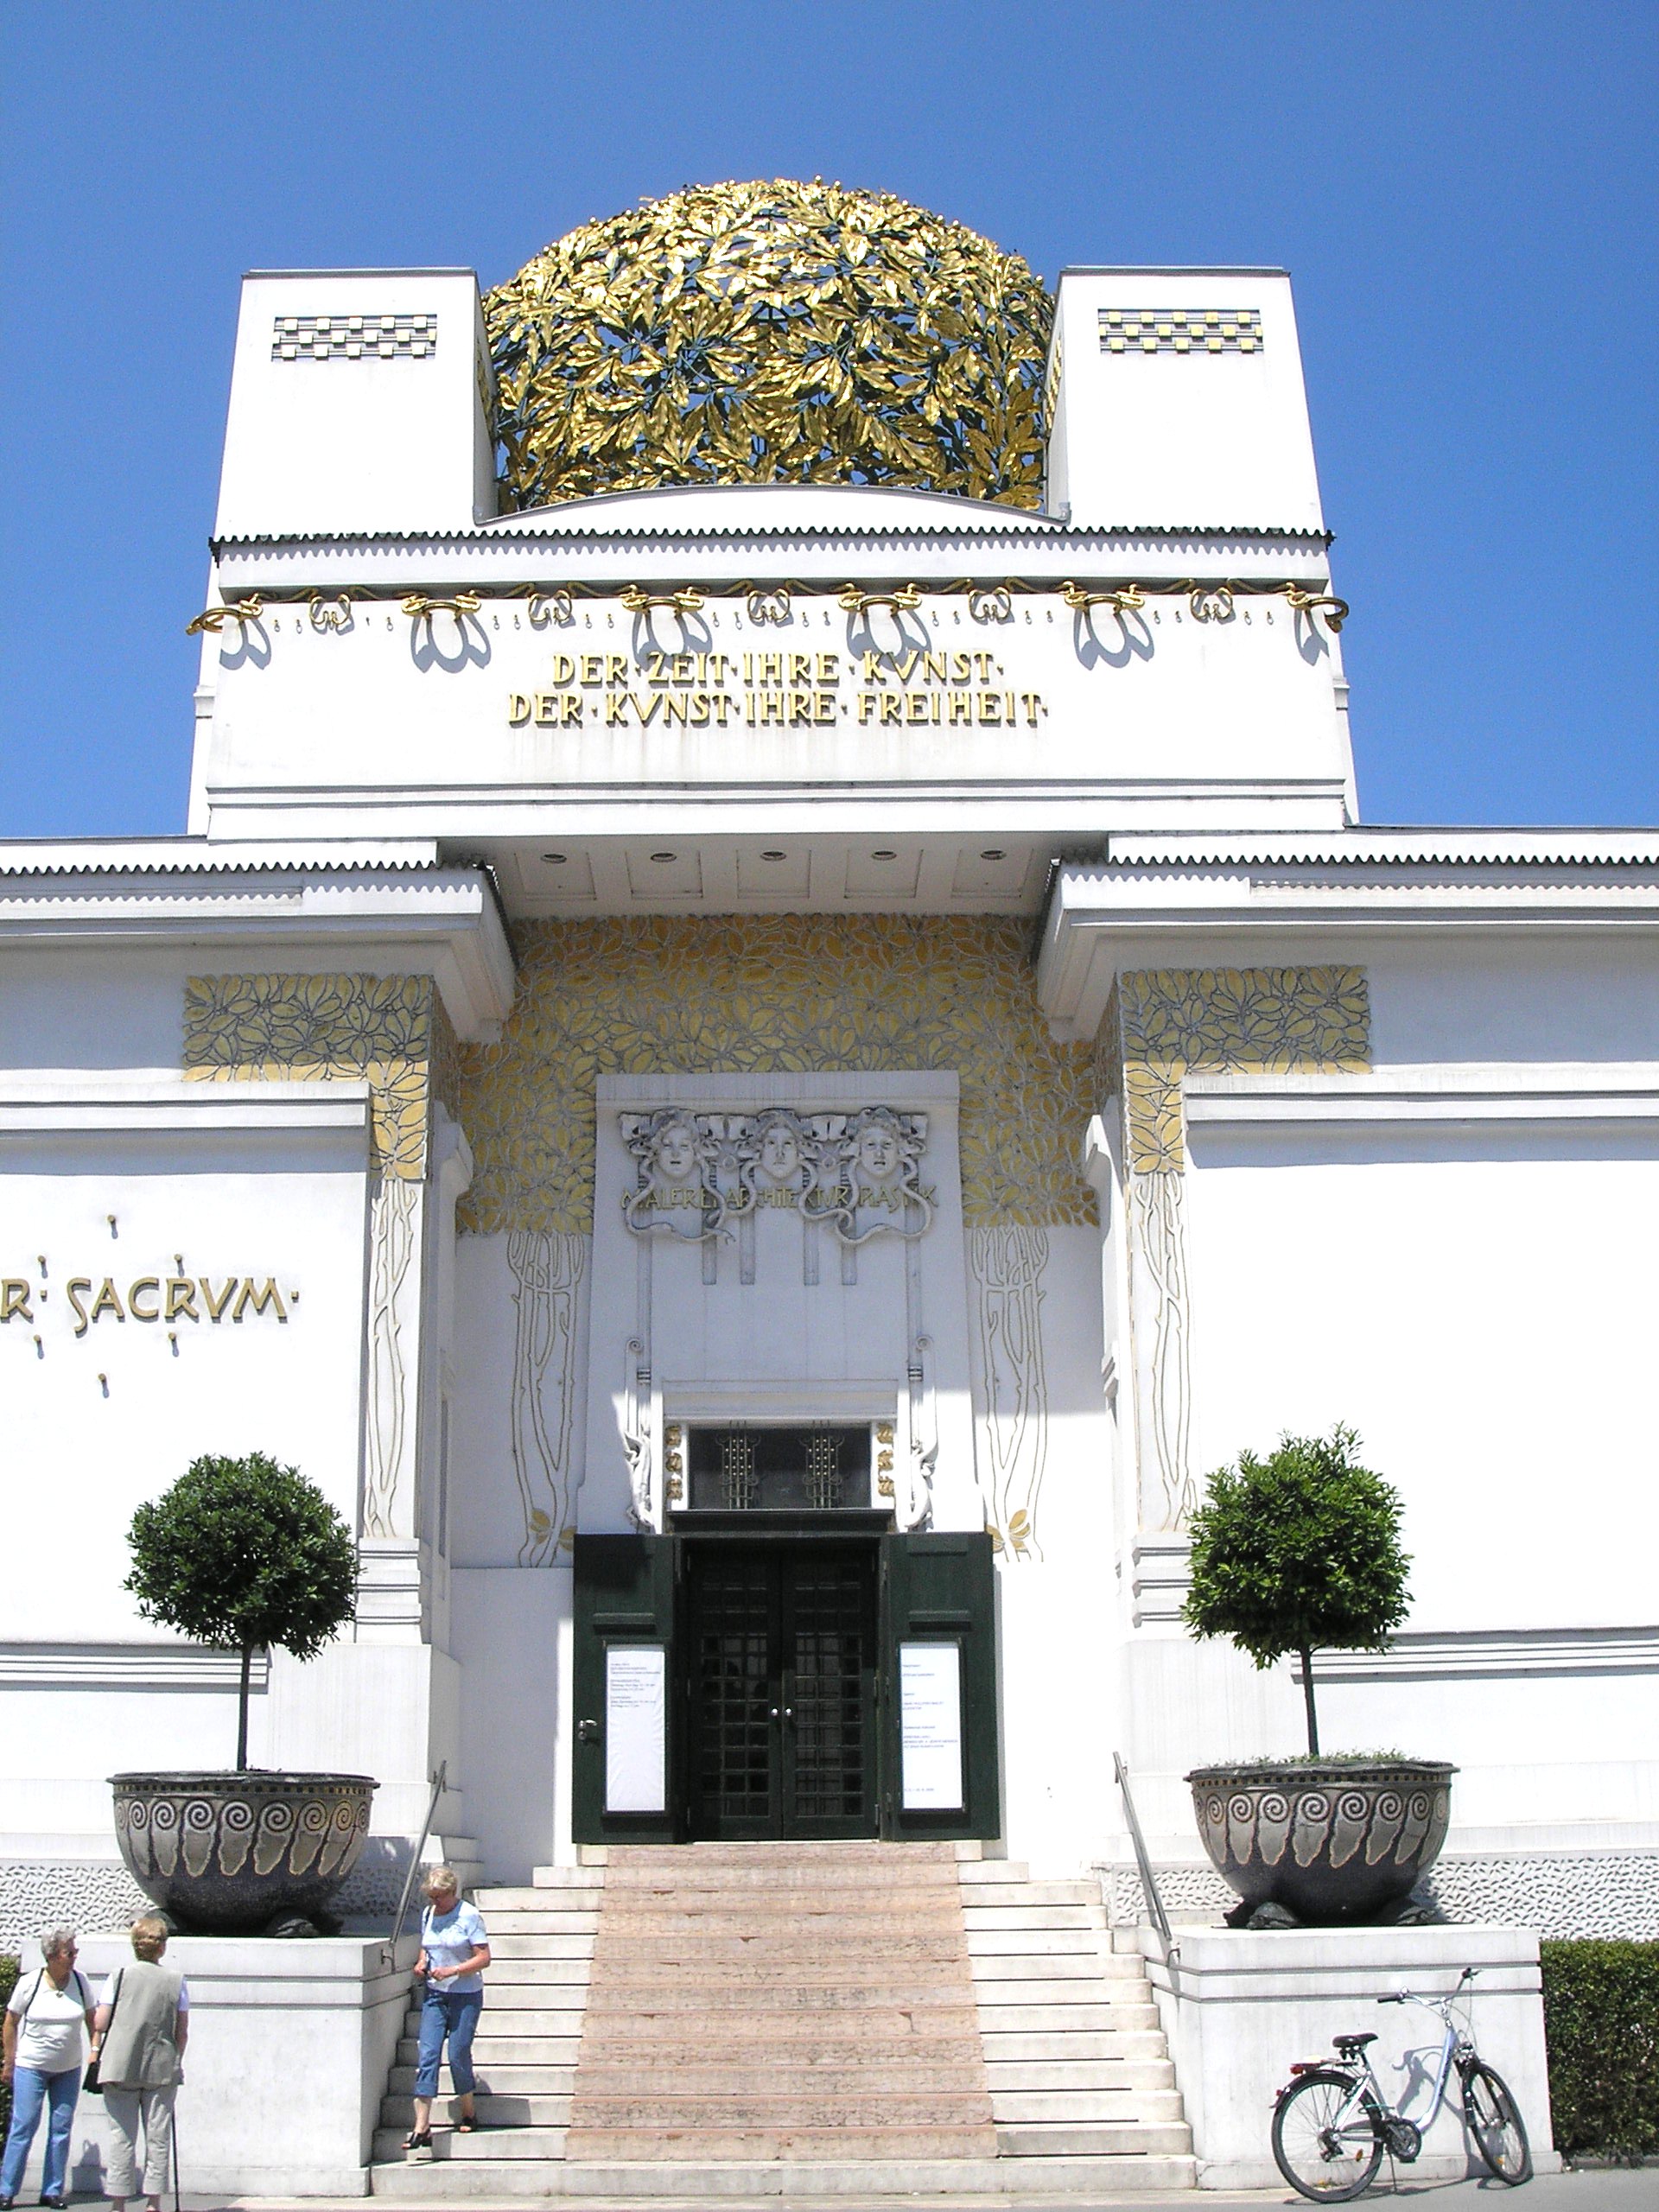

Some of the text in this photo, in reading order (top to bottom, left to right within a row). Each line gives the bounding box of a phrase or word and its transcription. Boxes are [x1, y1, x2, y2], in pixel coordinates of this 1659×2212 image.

[554, 652, 628, 688] DER
[648, 651, 729, 688] ZEIT
[743, 652, 839, 687] IHRE
[509, 692, 583, 728] DER
[746, 692, 836, 728] IHRE
[858, 691, 1041, 728] FREIHEIT
